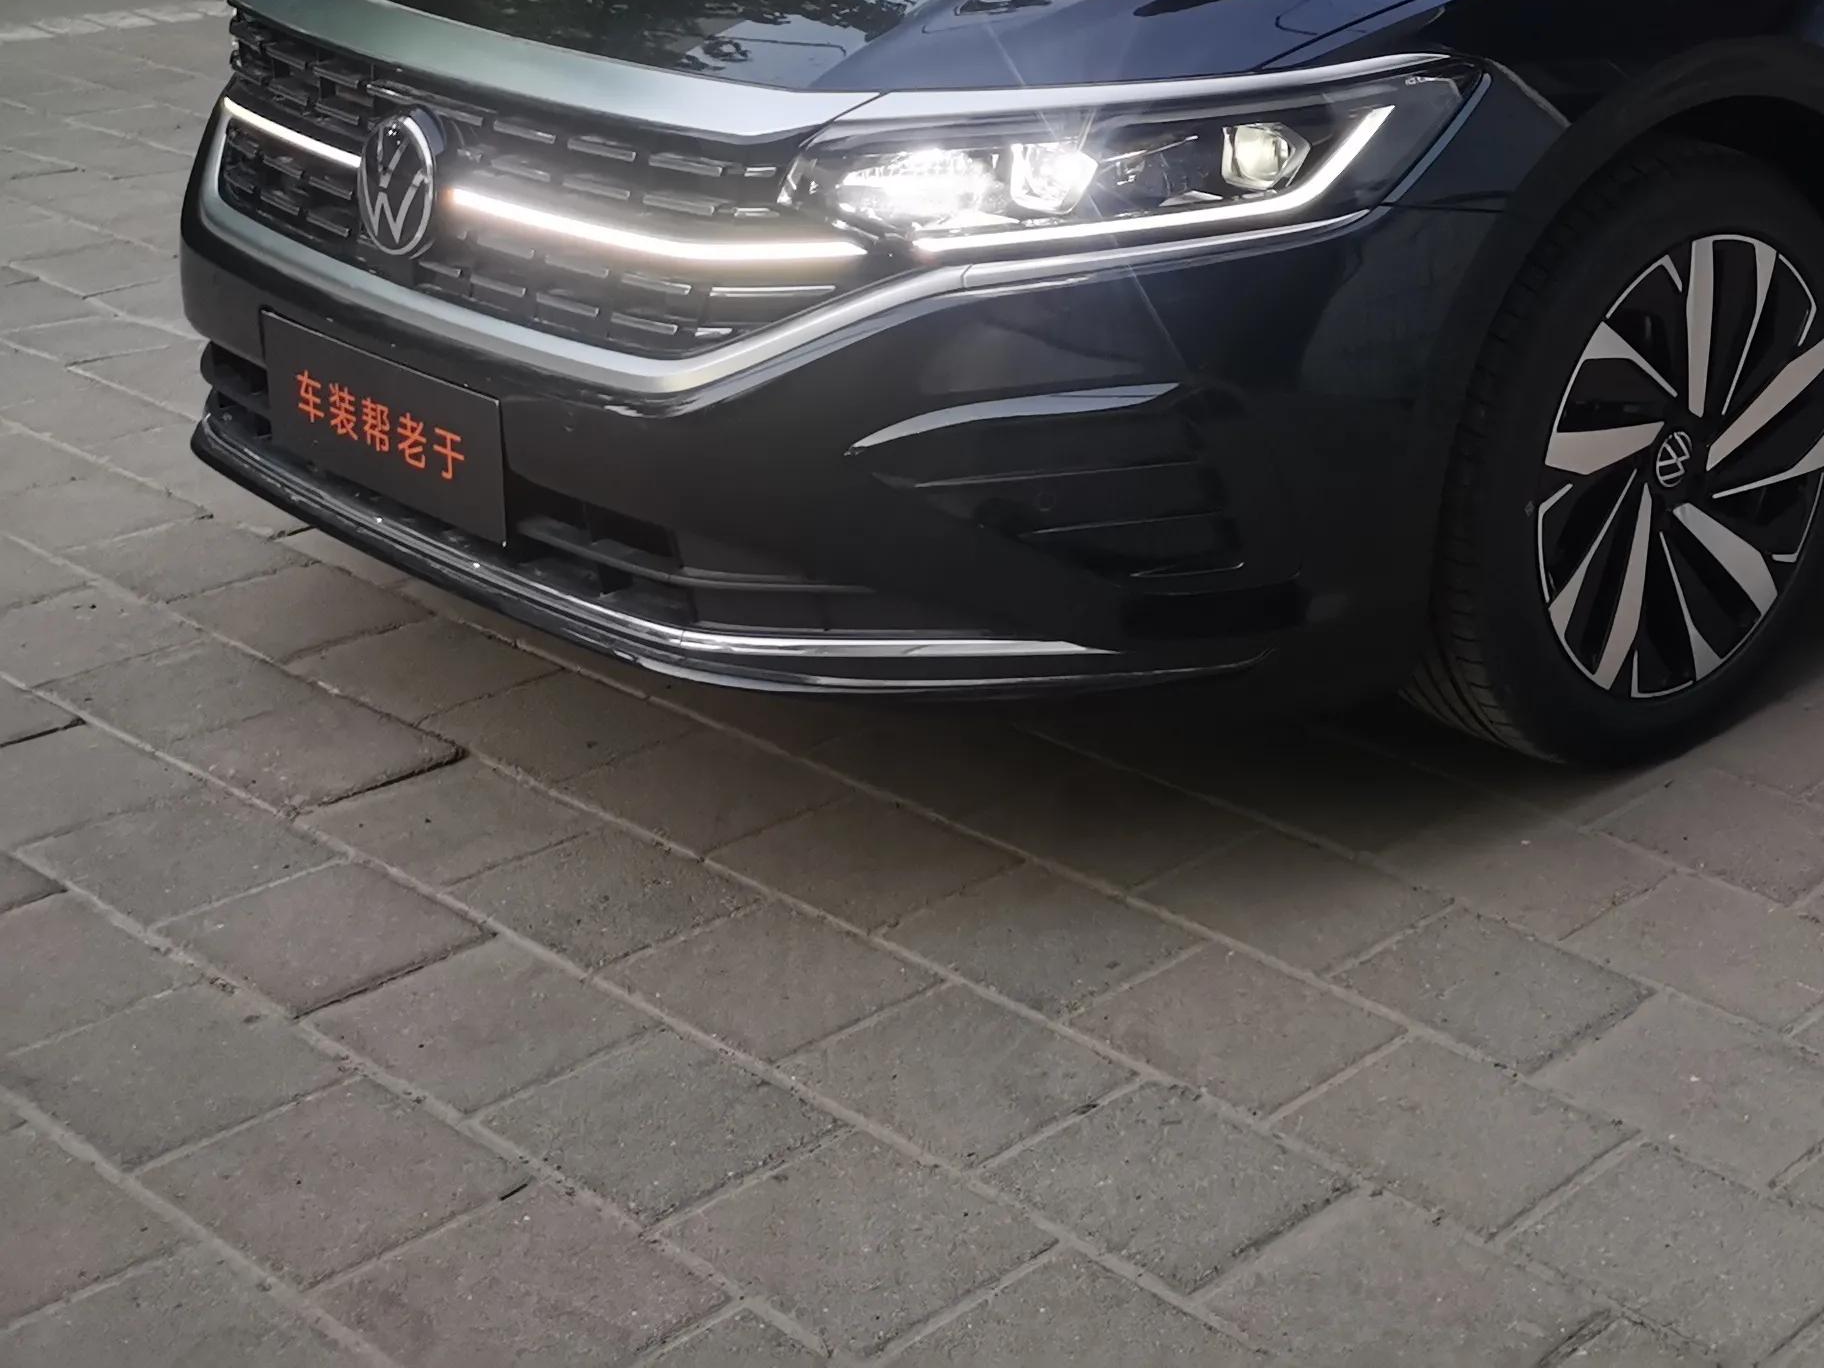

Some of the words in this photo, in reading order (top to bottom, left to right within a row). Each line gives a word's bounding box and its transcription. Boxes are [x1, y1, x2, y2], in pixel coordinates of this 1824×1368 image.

[296, 369, 465, 480] 车装帮老于
